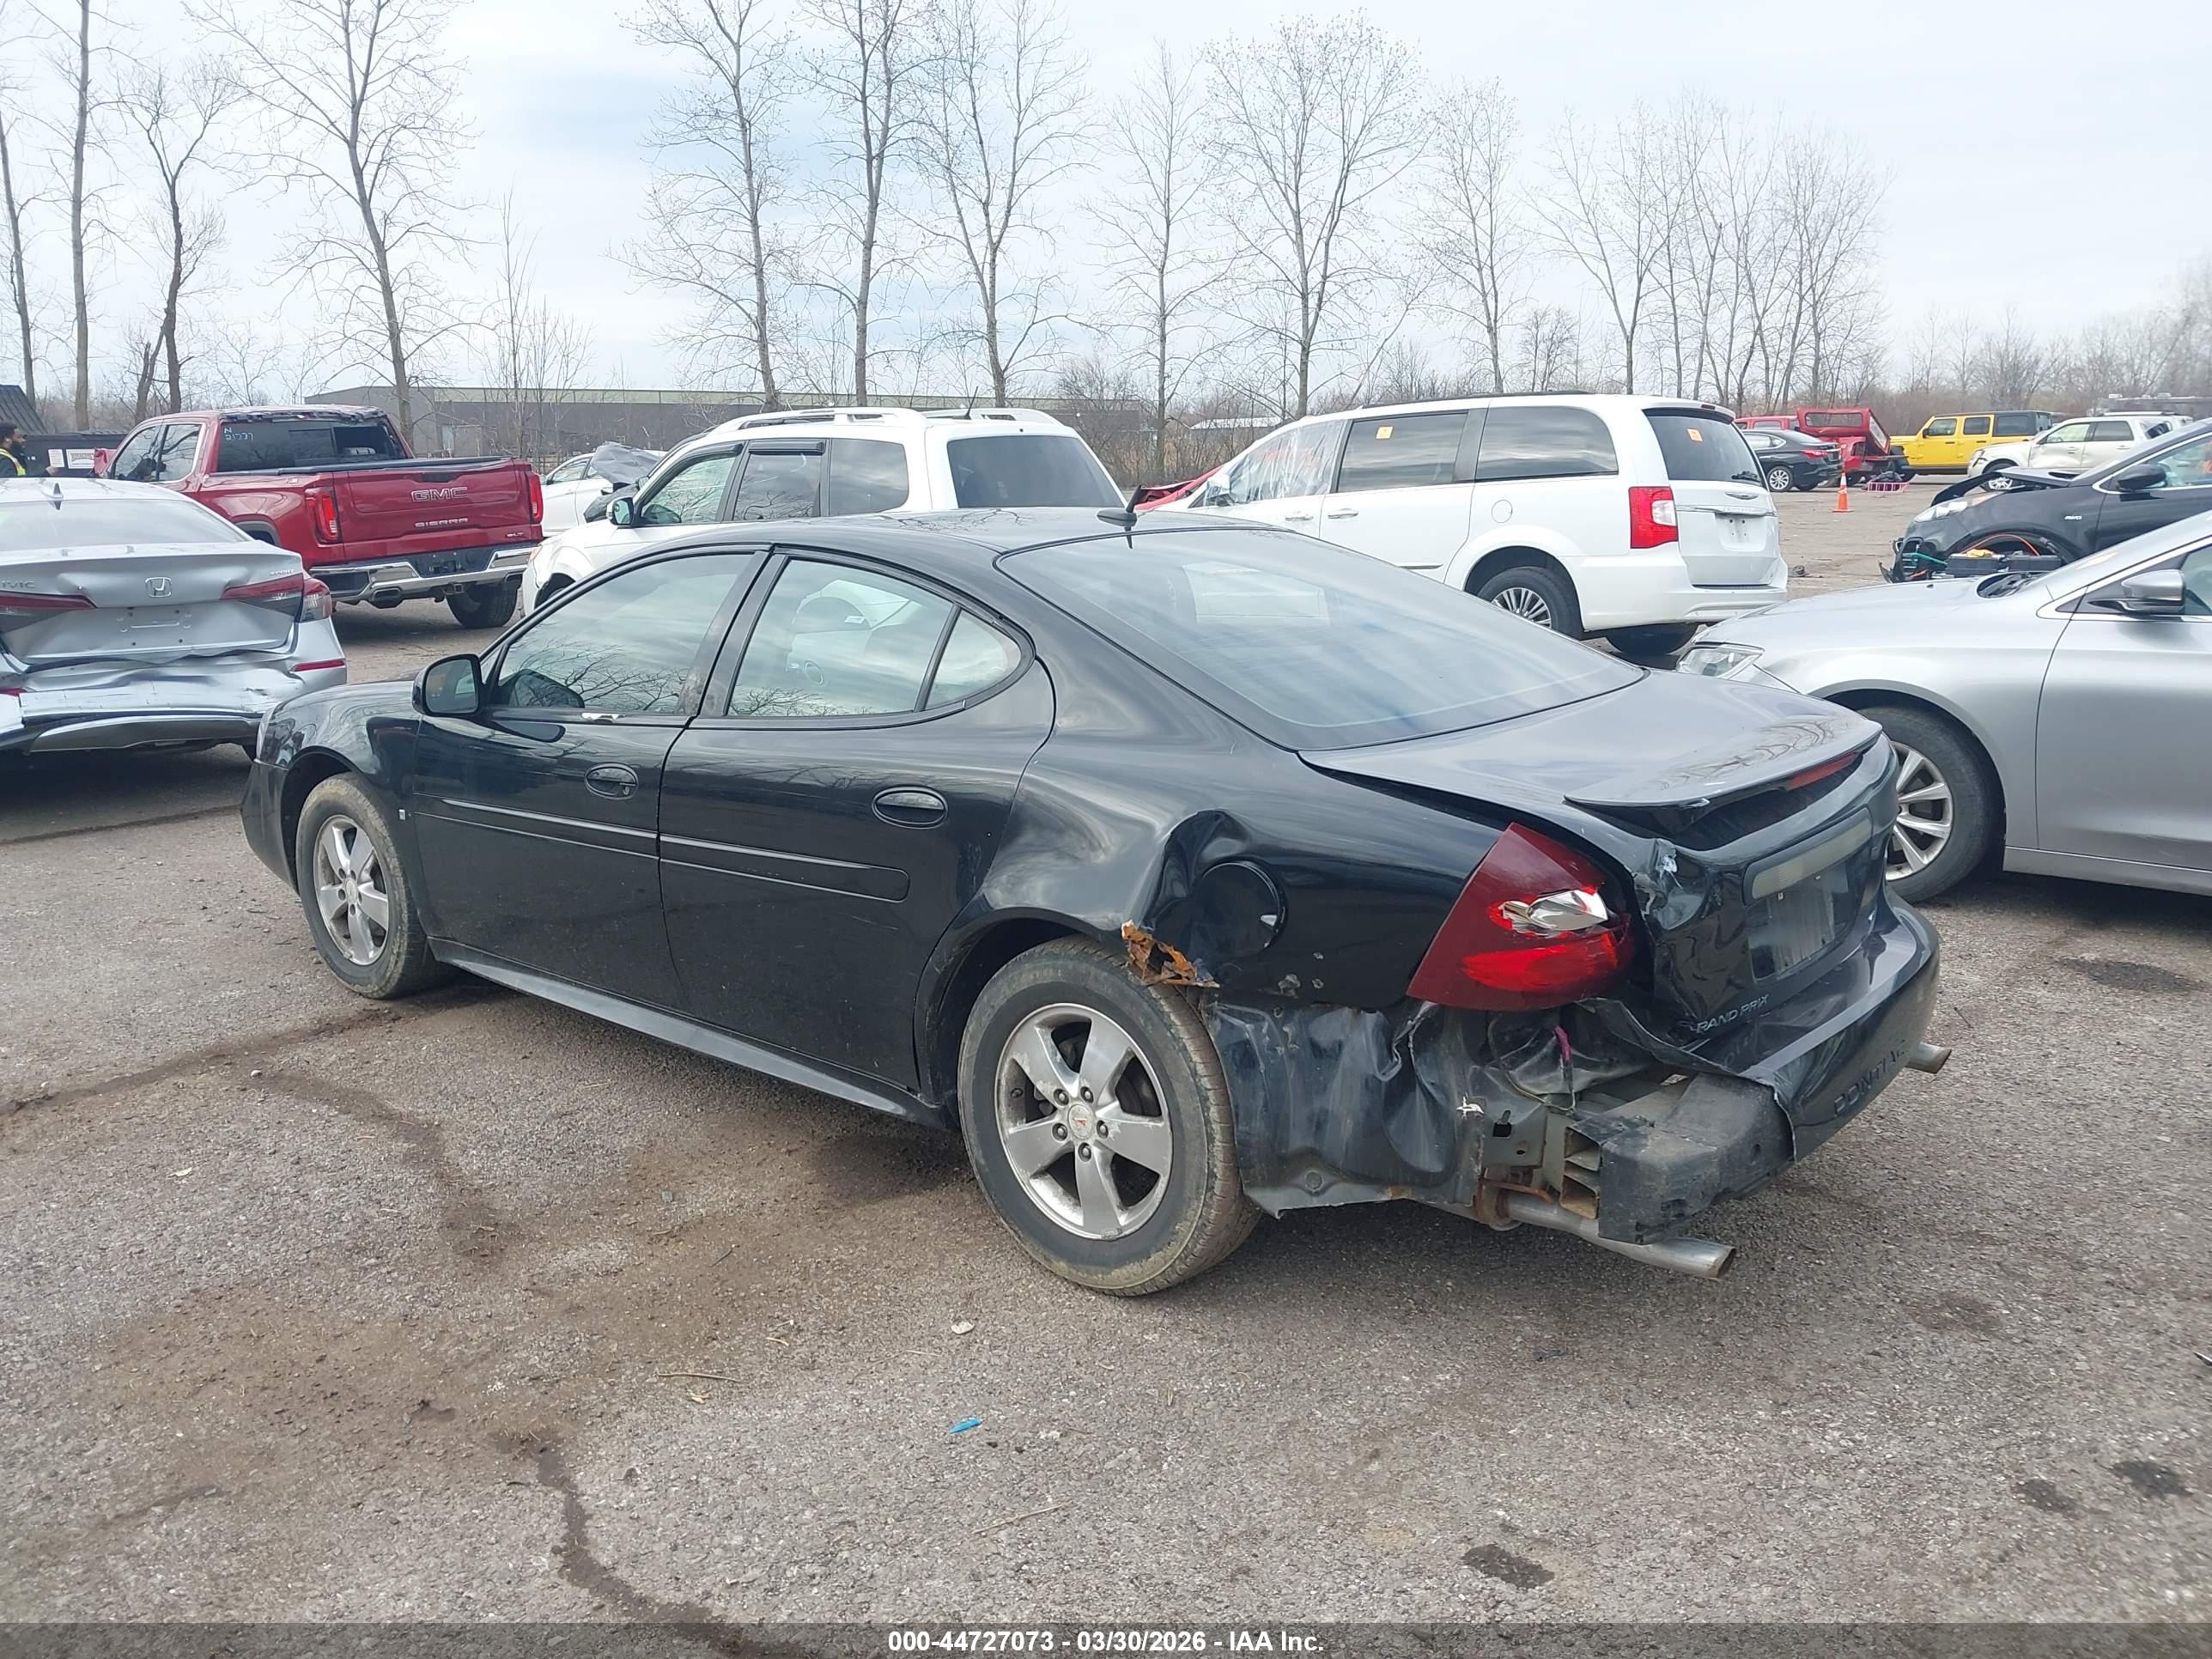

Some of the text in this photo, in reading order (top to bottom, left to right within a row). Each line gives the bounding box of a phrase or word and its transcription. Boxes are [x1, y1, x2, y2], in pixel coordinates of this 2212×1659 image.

[410, 486, 468, 502] GMC
[415, 518, 469, 527] SIERRA
[0, 580, 35, 589] IVIC
[1689, 994, 1770, 1034] RAND PRIX
[1833, 1039, 1906, 1115] PONTIAC
